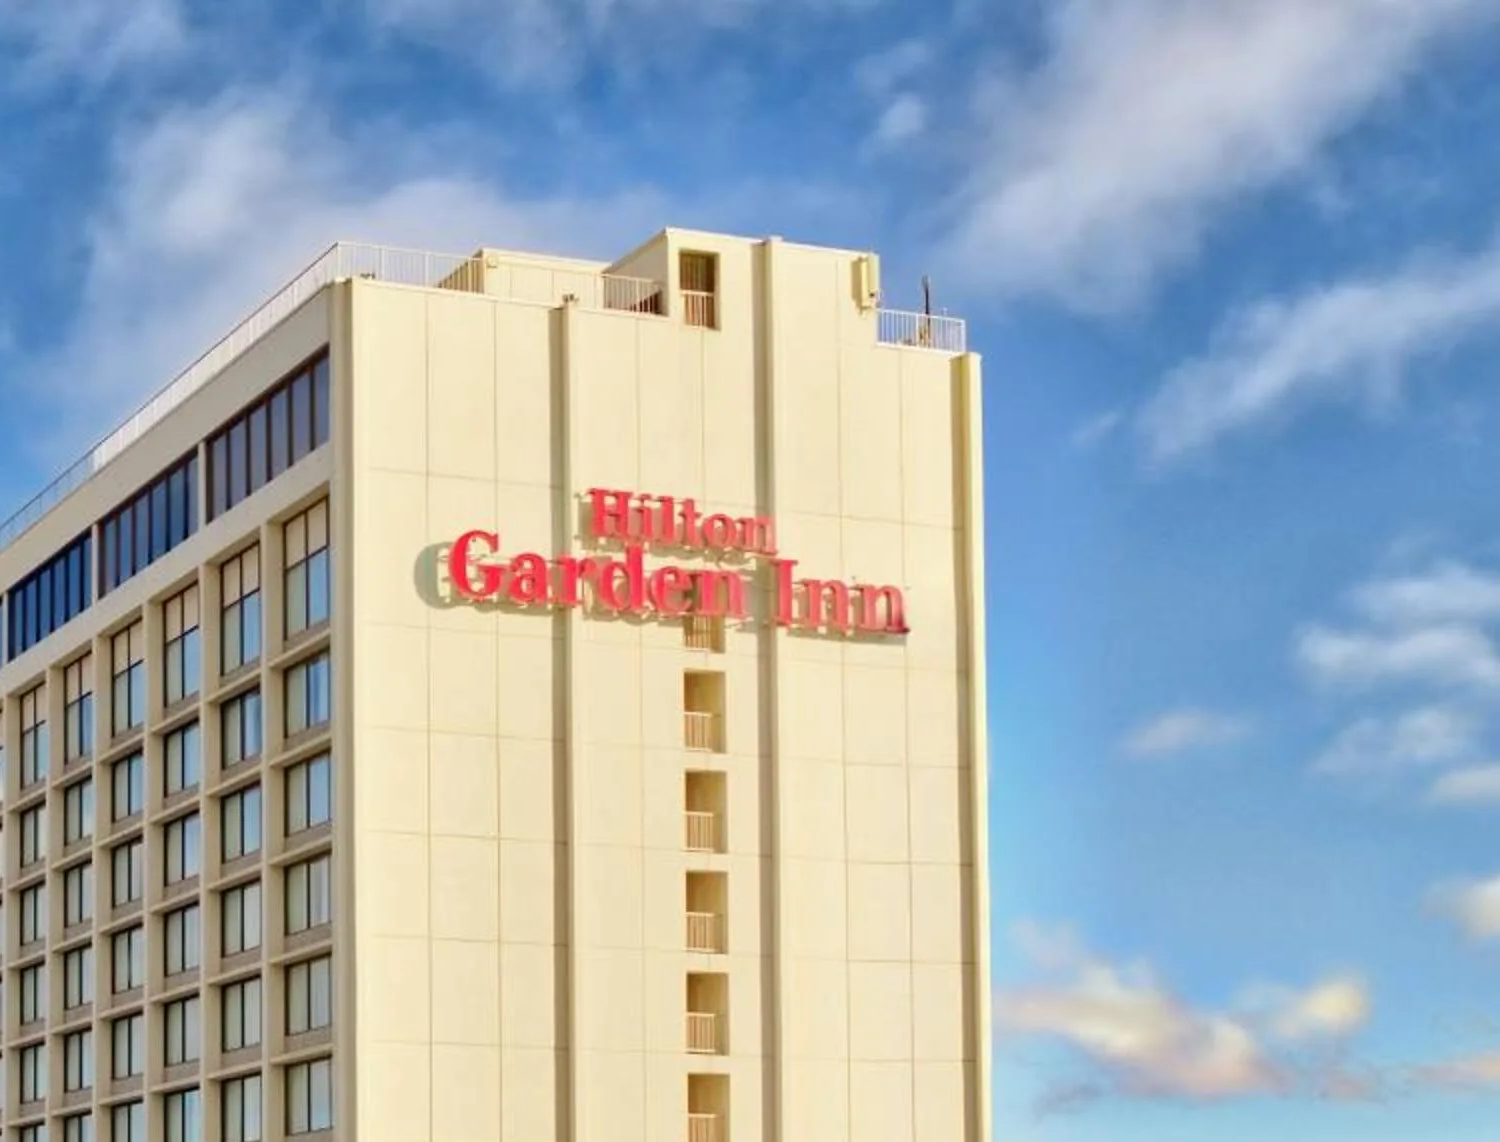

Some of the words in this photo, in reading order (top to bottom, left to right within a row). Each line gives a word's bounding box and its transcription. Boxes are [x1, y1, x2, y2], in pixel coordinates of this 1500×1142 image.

[586, 487, 779, 555] Hilton
[448, 529, 747, 618] Garden
[770, 557, 911, 634] Inn
